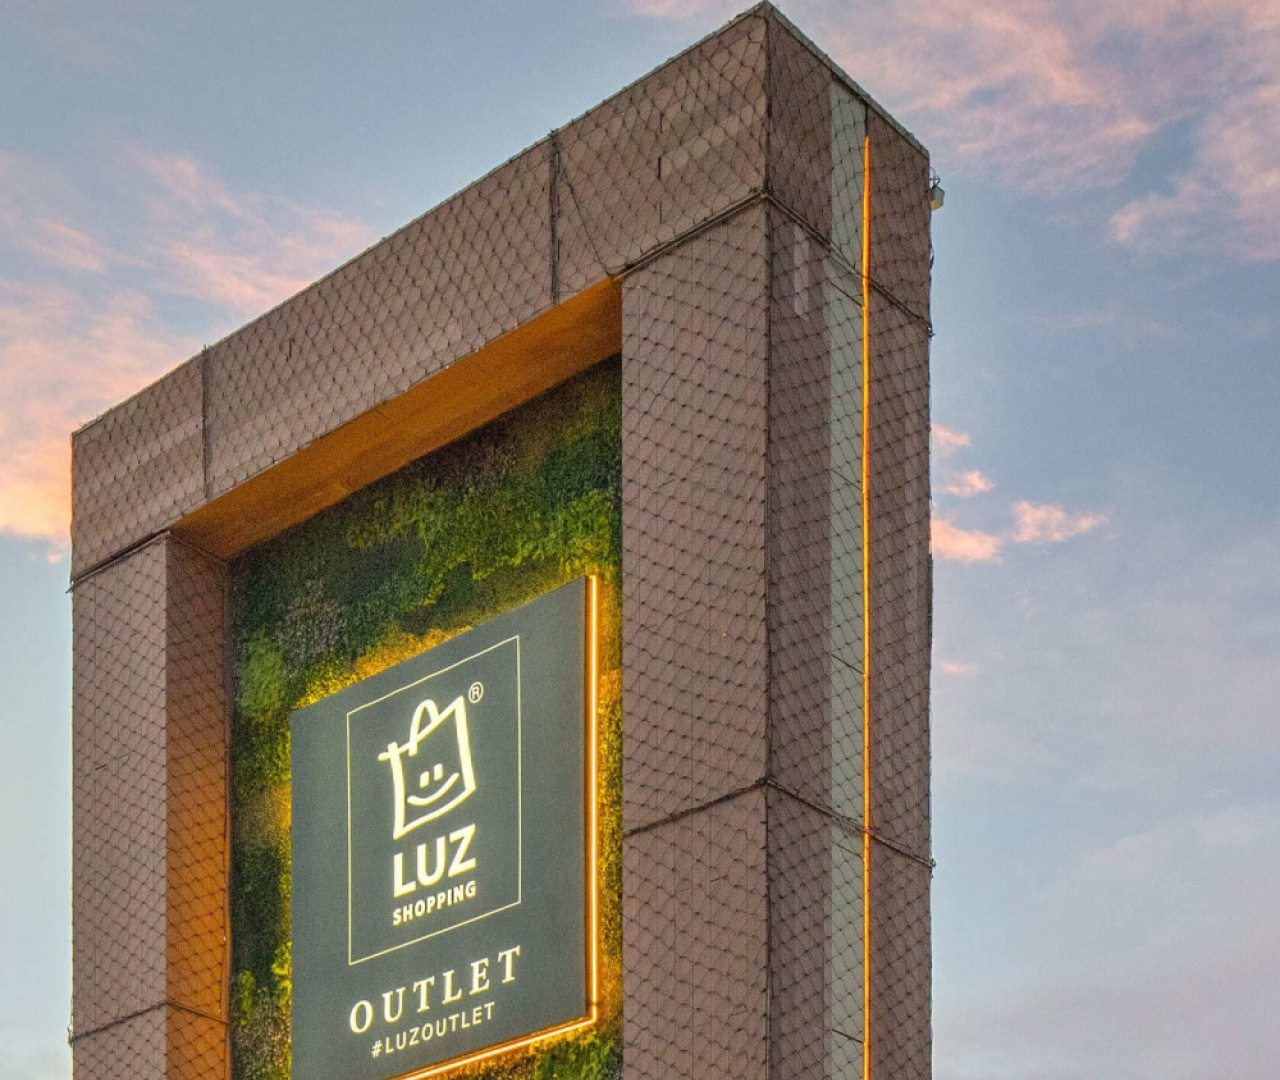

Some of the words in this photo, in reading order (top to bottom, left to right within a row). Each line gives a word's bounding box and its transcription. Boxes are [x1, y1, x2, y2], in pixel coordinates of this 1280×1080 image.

[393, 824, 477, 898] LUZ
[392, 880, 477, 926] SHOPPING
[349, 945, 522, 1034] OUTLET
[371, 1002, 496, 1058] #LUZOUTLET
